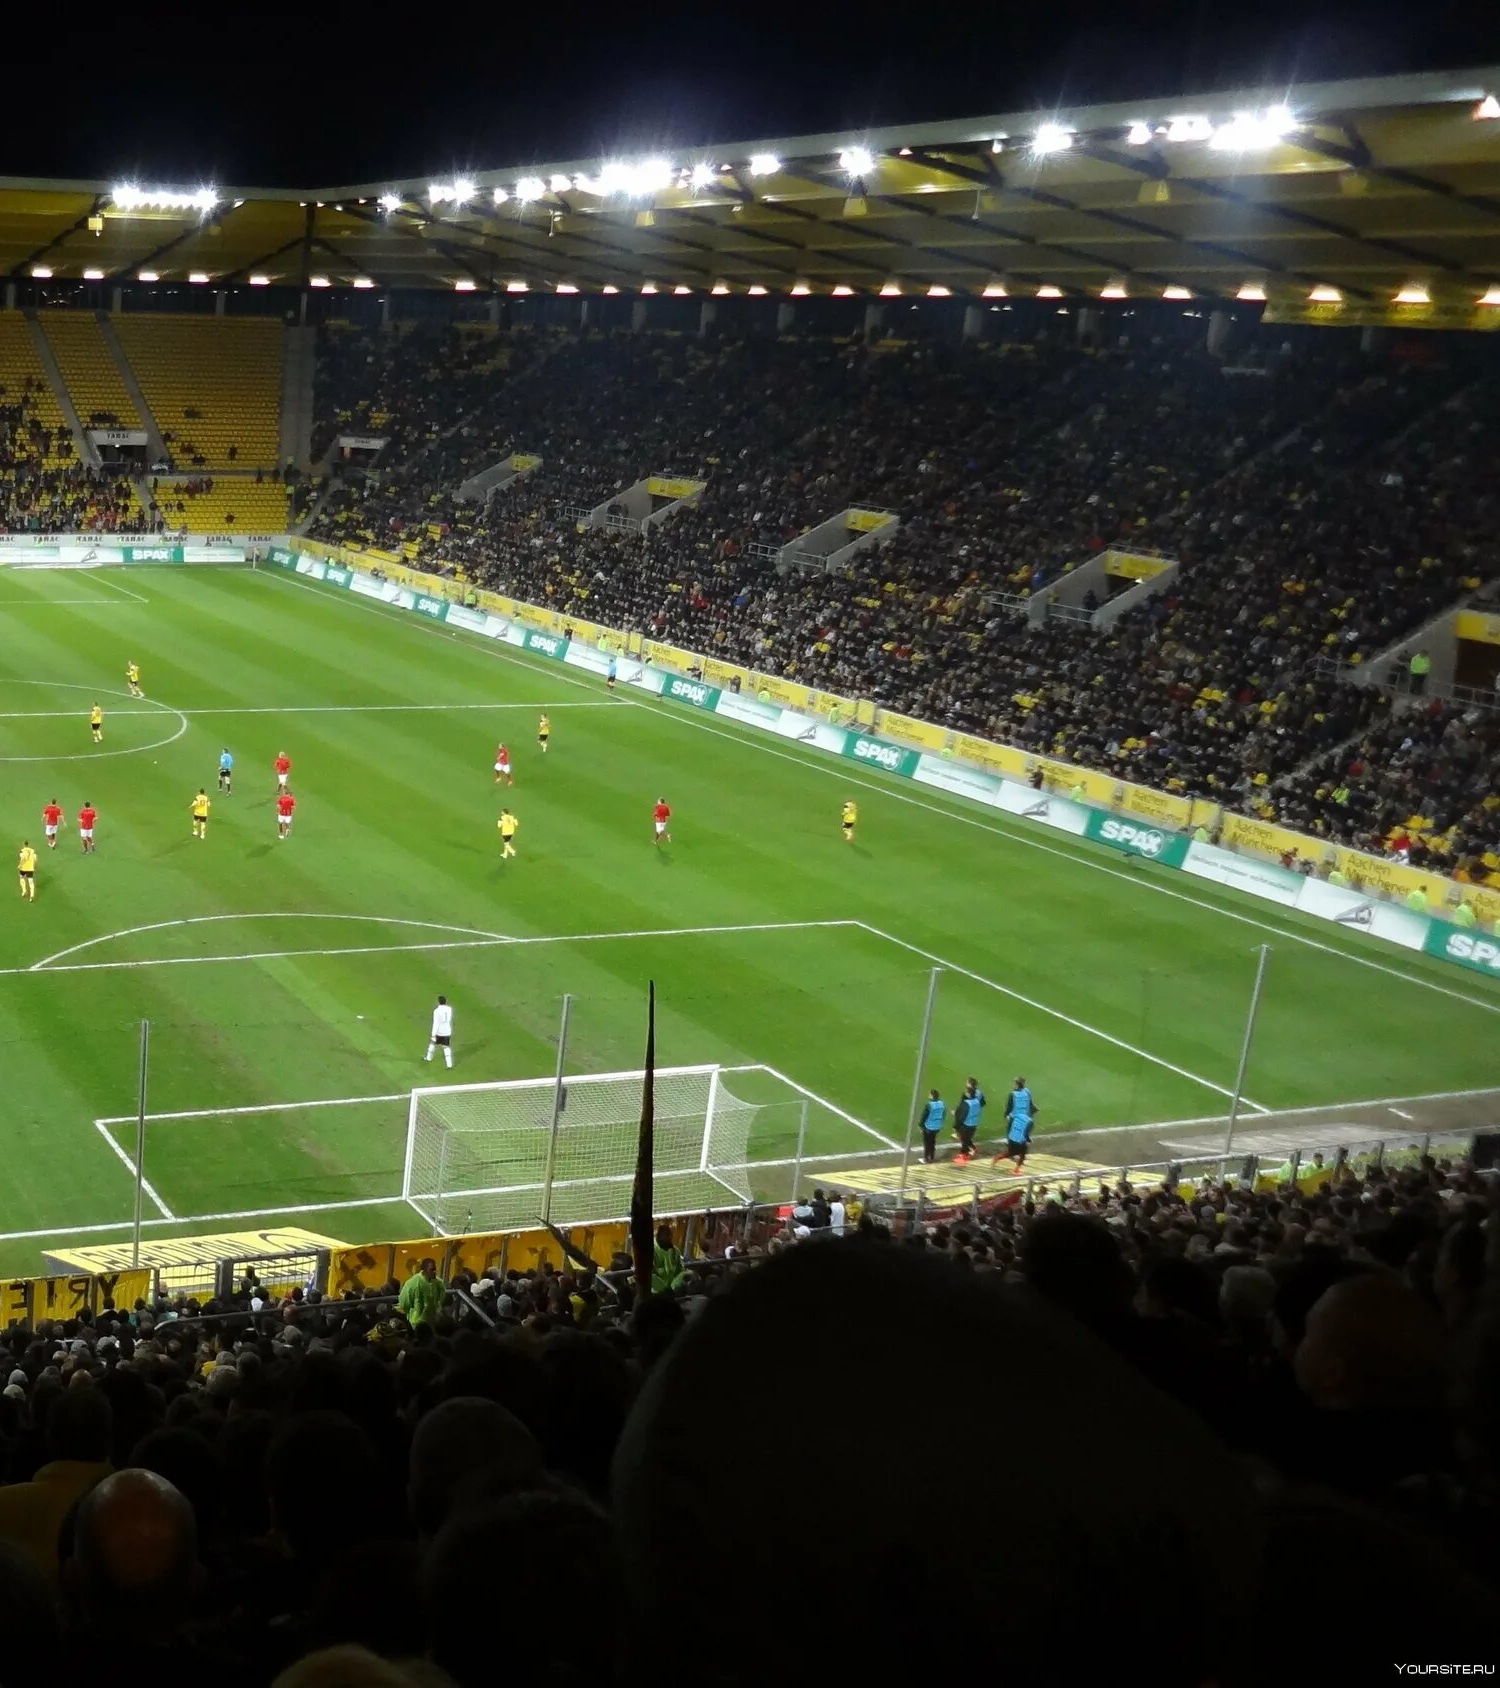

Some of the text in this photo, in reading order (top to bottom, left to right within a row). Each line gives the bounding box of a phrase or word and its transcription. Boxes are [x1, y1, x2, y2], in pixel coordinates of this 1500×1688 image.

[132, 550, 170, 560] SPAX
[530, 634, 558, 654] SPAX
[671, 681, 707, 703] SPAX
[853, 740, 900, 766] SPAX
[1100, 820, 1162, 852] SPAX
[1347, 854, 1391, 877] Aachen
